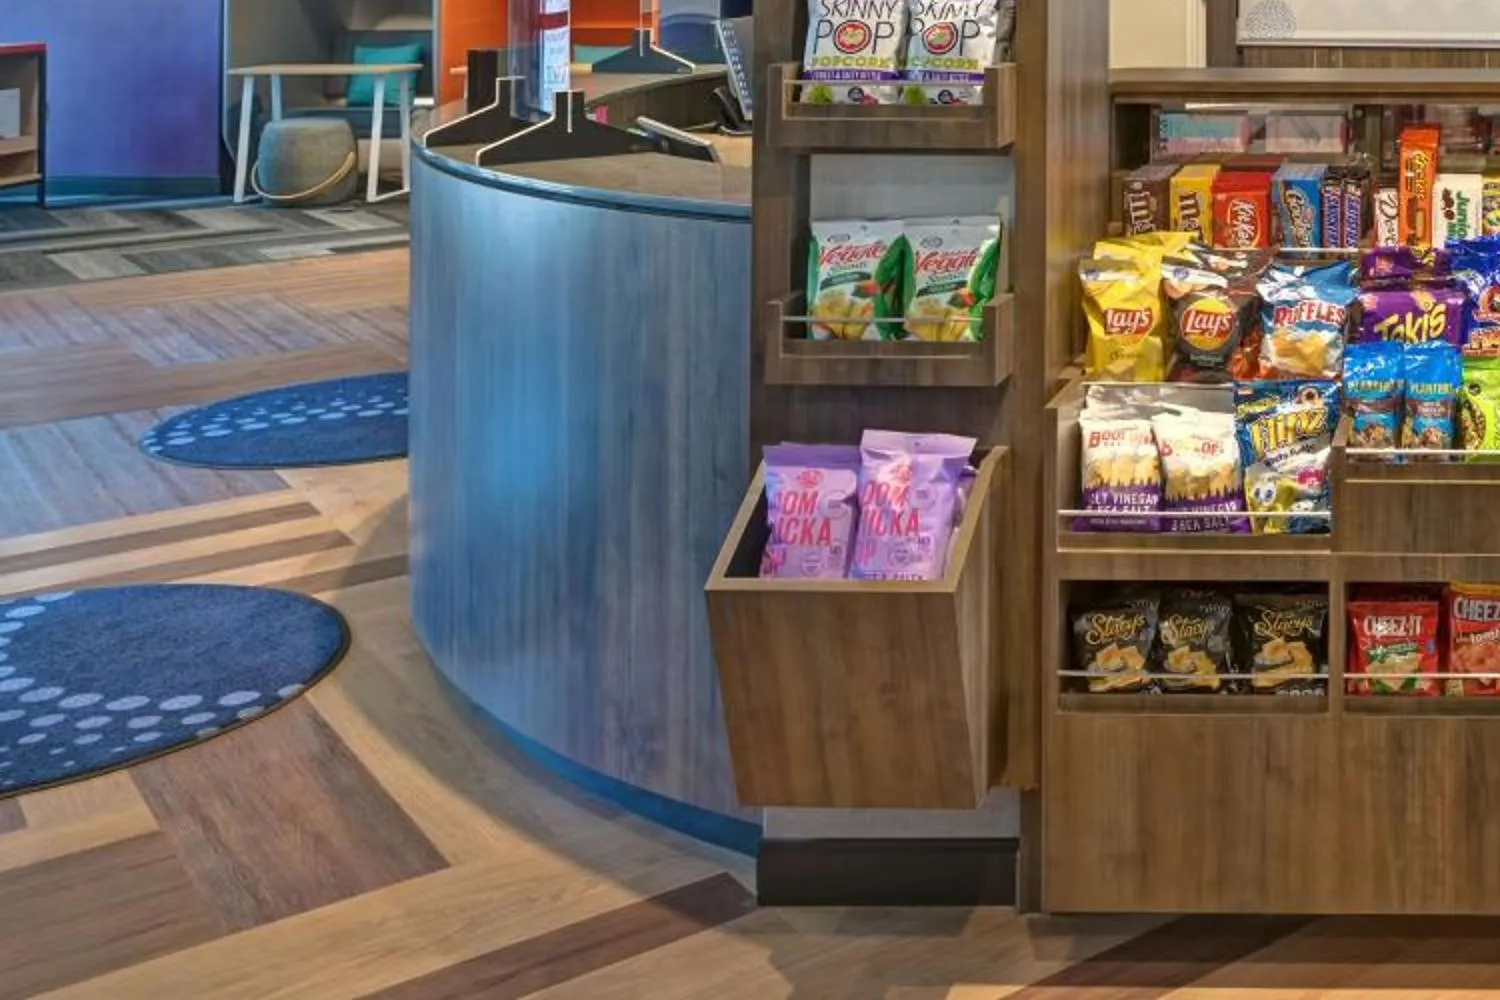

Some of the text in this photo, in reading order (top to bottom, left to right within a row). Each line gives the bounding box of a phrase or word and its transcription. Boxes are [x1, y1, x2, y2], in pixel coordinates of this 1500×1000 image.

[813, 19, 895, 55] POP
[1455, 188, 1471, 239] Junio
[1105, 308, 1151, 334] Lay's
[1183, 310, 1232, 337] Lay's
